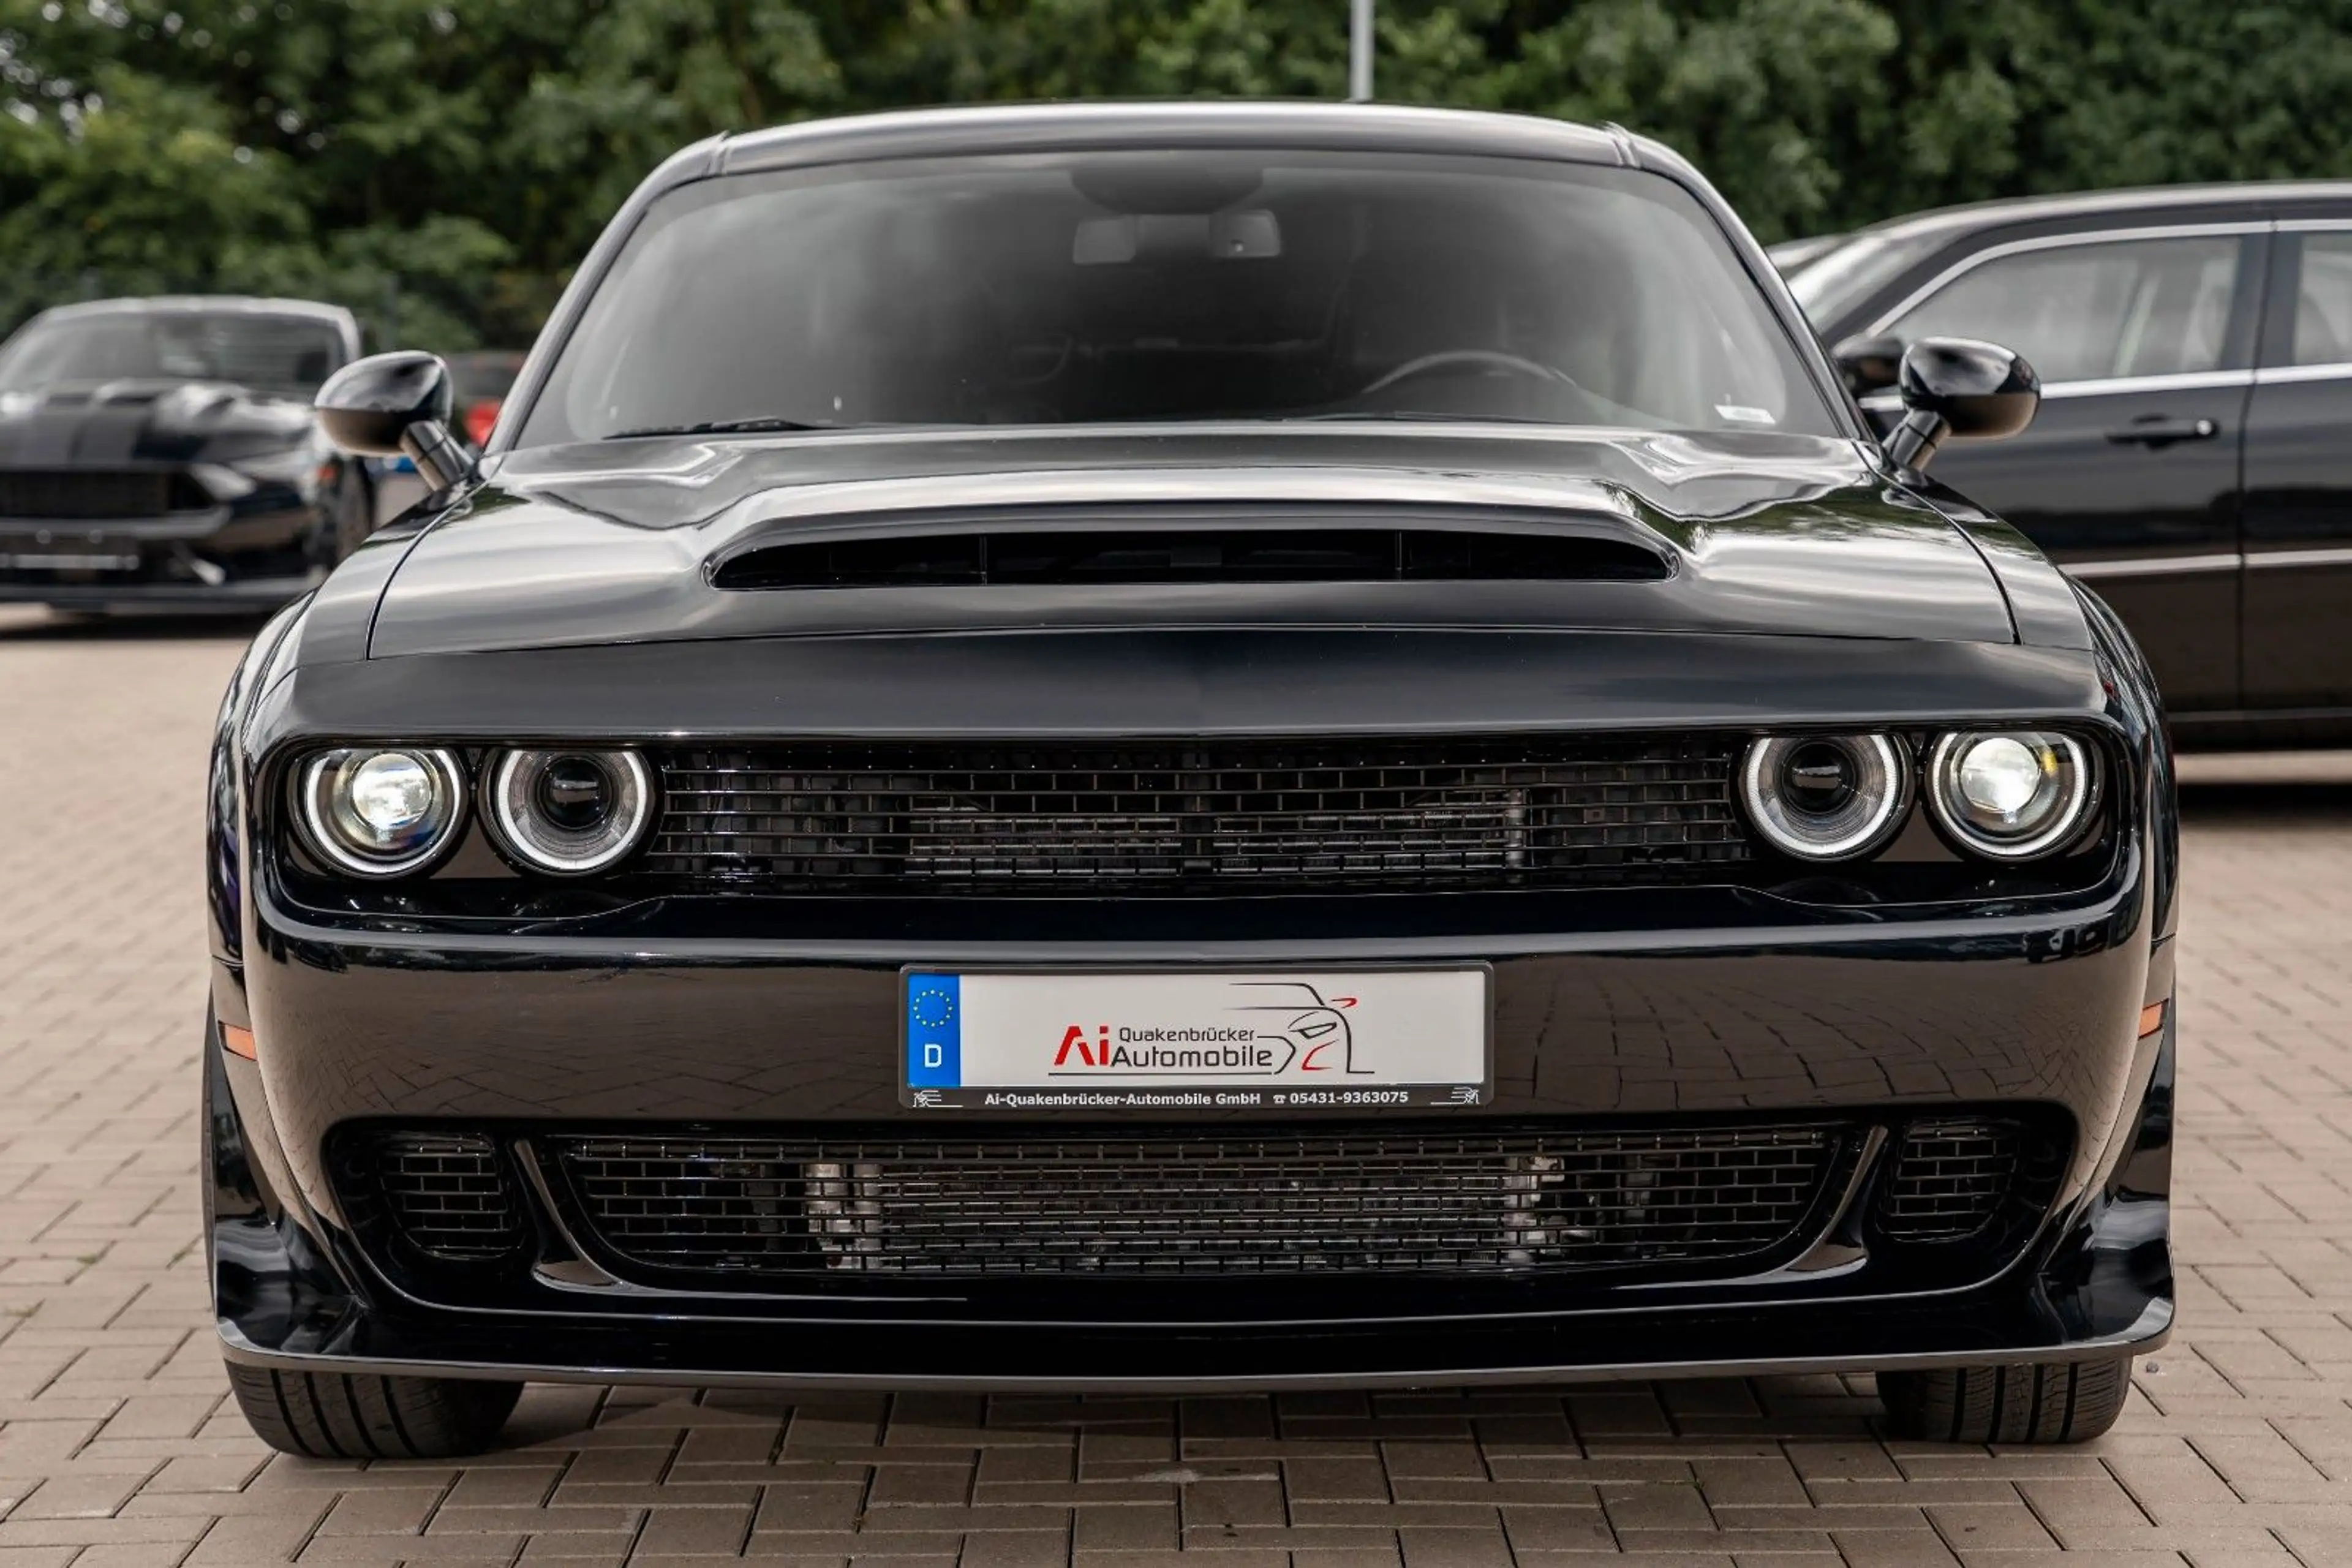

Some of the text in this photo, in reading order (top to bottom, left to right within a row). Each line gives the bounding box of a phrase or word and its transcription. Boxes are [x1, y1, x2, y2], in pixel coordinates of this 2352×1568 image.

[1119, 1027, 1255, 1043] Quakenbrücker
[924, 1044, 942, 1068] D
[1054, 1025, 1273, 1068] Ai Automobile
[984, 1091, 1409, 1107] Ai-Quakenbrücker-Automobile GmbH 05431-9363075
